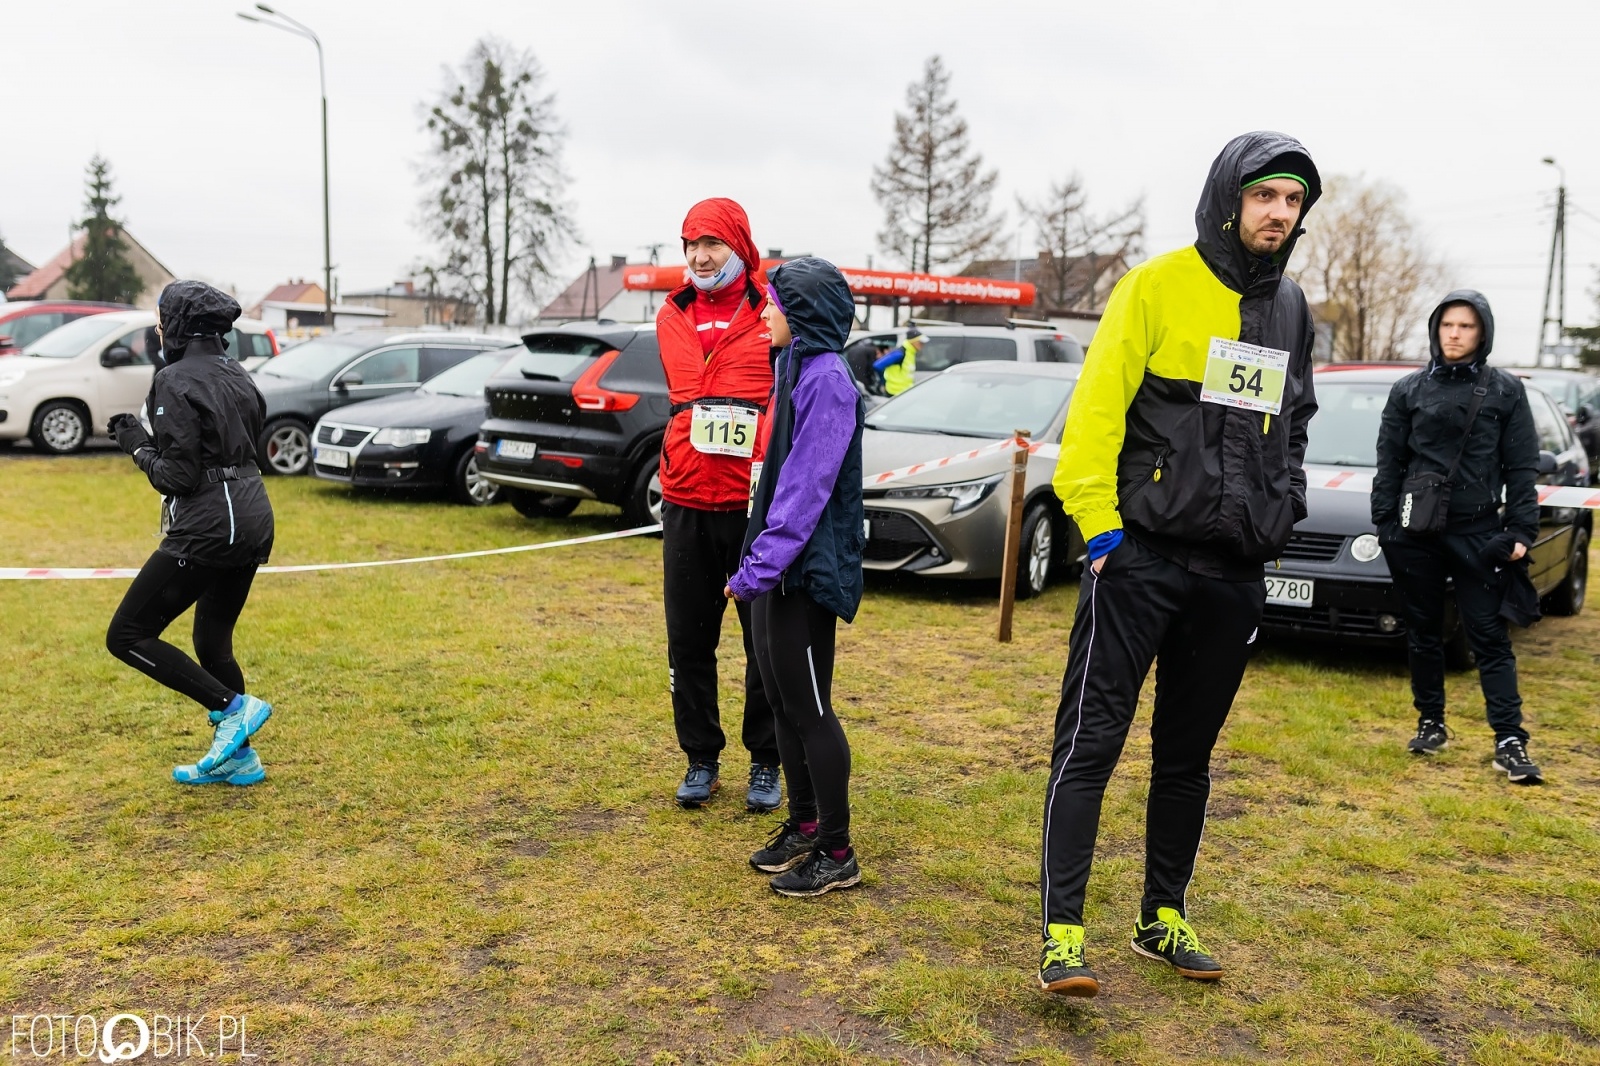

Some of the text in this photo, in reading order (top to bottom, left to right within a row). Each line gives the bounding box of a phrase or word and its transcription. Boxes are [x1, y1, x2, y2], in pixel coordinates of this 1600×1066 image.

[1228, 364, 1263, 397] 54
[704, 421, 746, 446] 115
[1402, 492, 1413, 528] adidas
[1265, 579, 1311, 601] 2780
